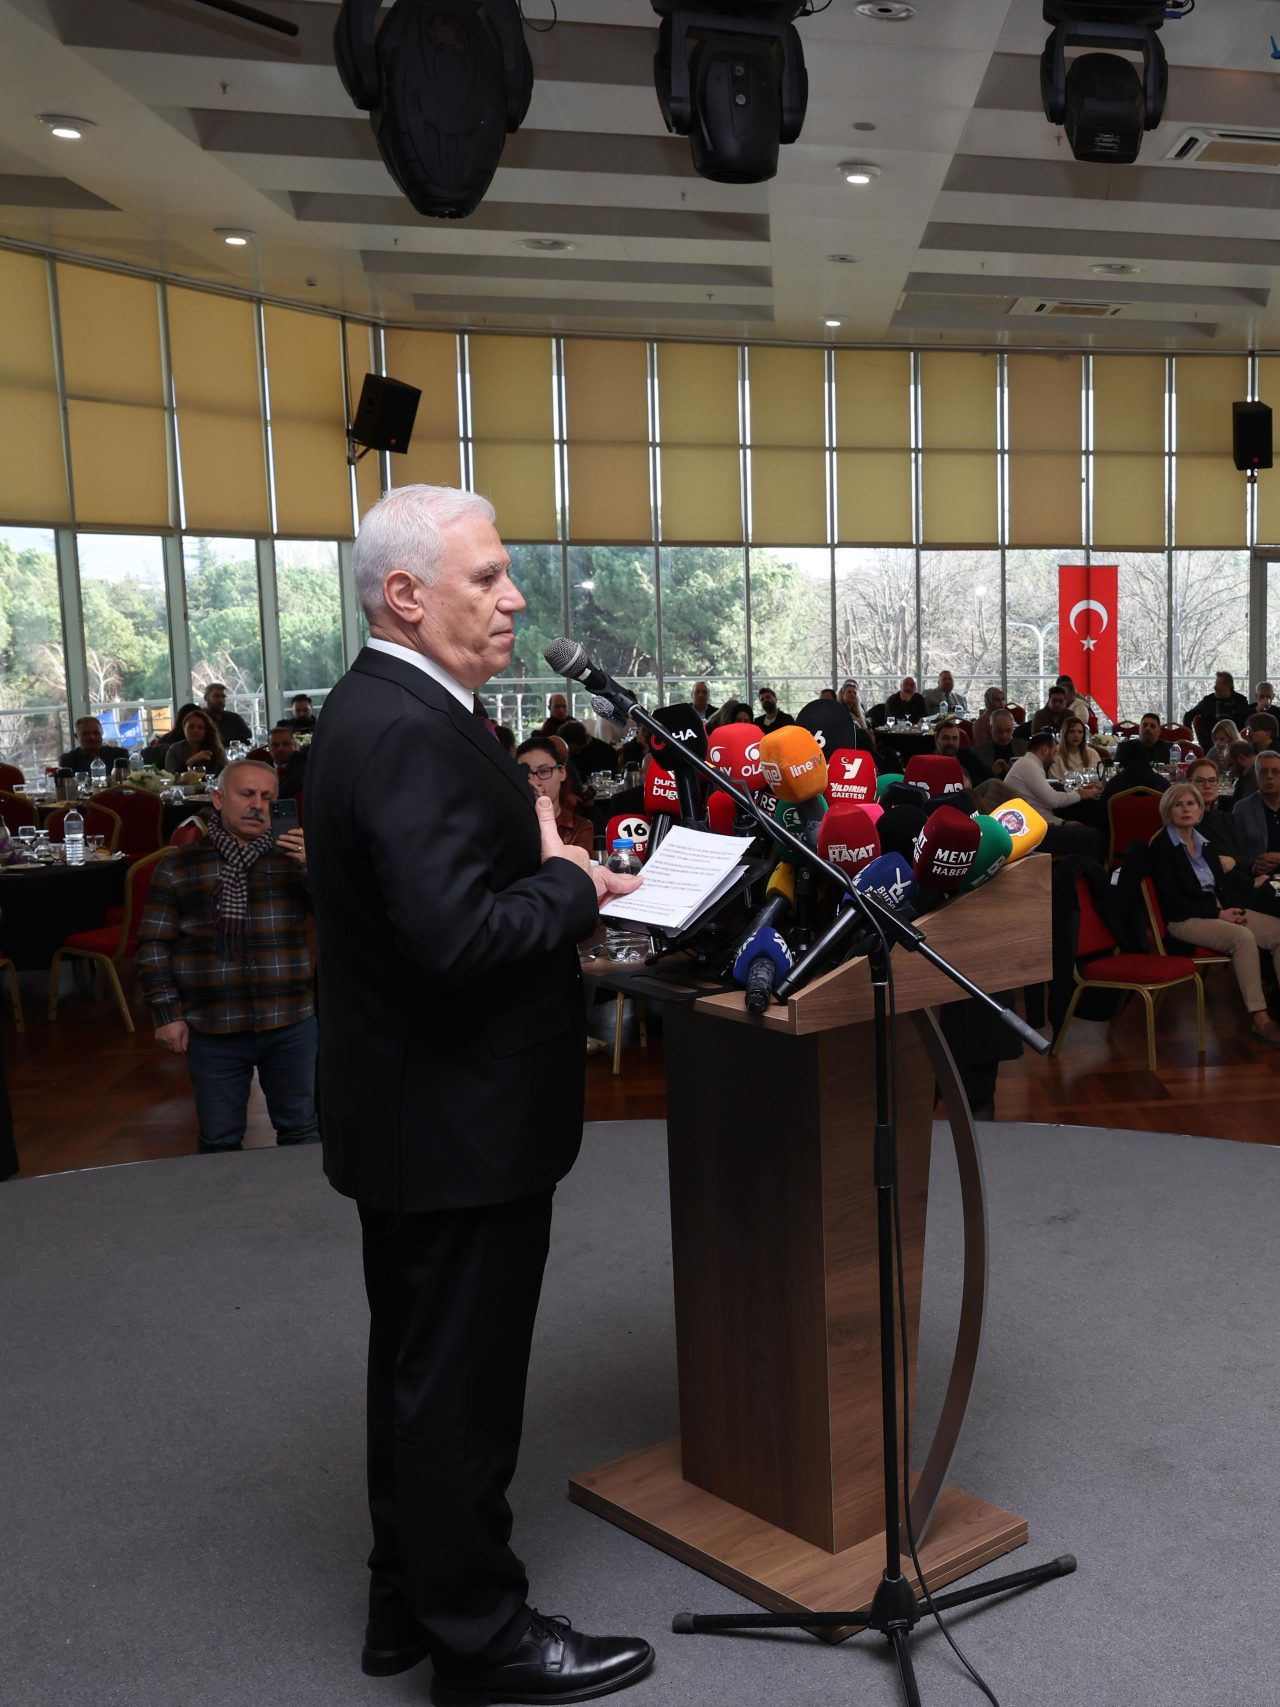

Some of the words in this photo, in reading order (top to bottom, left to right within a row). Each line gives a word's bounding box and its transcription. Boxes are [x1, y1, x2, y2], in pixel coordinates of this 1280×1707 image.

[654, 776, 677, 788] burs
[830, 782, 867, 794] YILDIRIM
[652, 786, 679, 801] bug
[622, 823, 647, 837] 16
[828, 843, 876, 863] HAYAT
[934, 848, 977, 864] MENT
[931, 865, 968, 877] HABER
